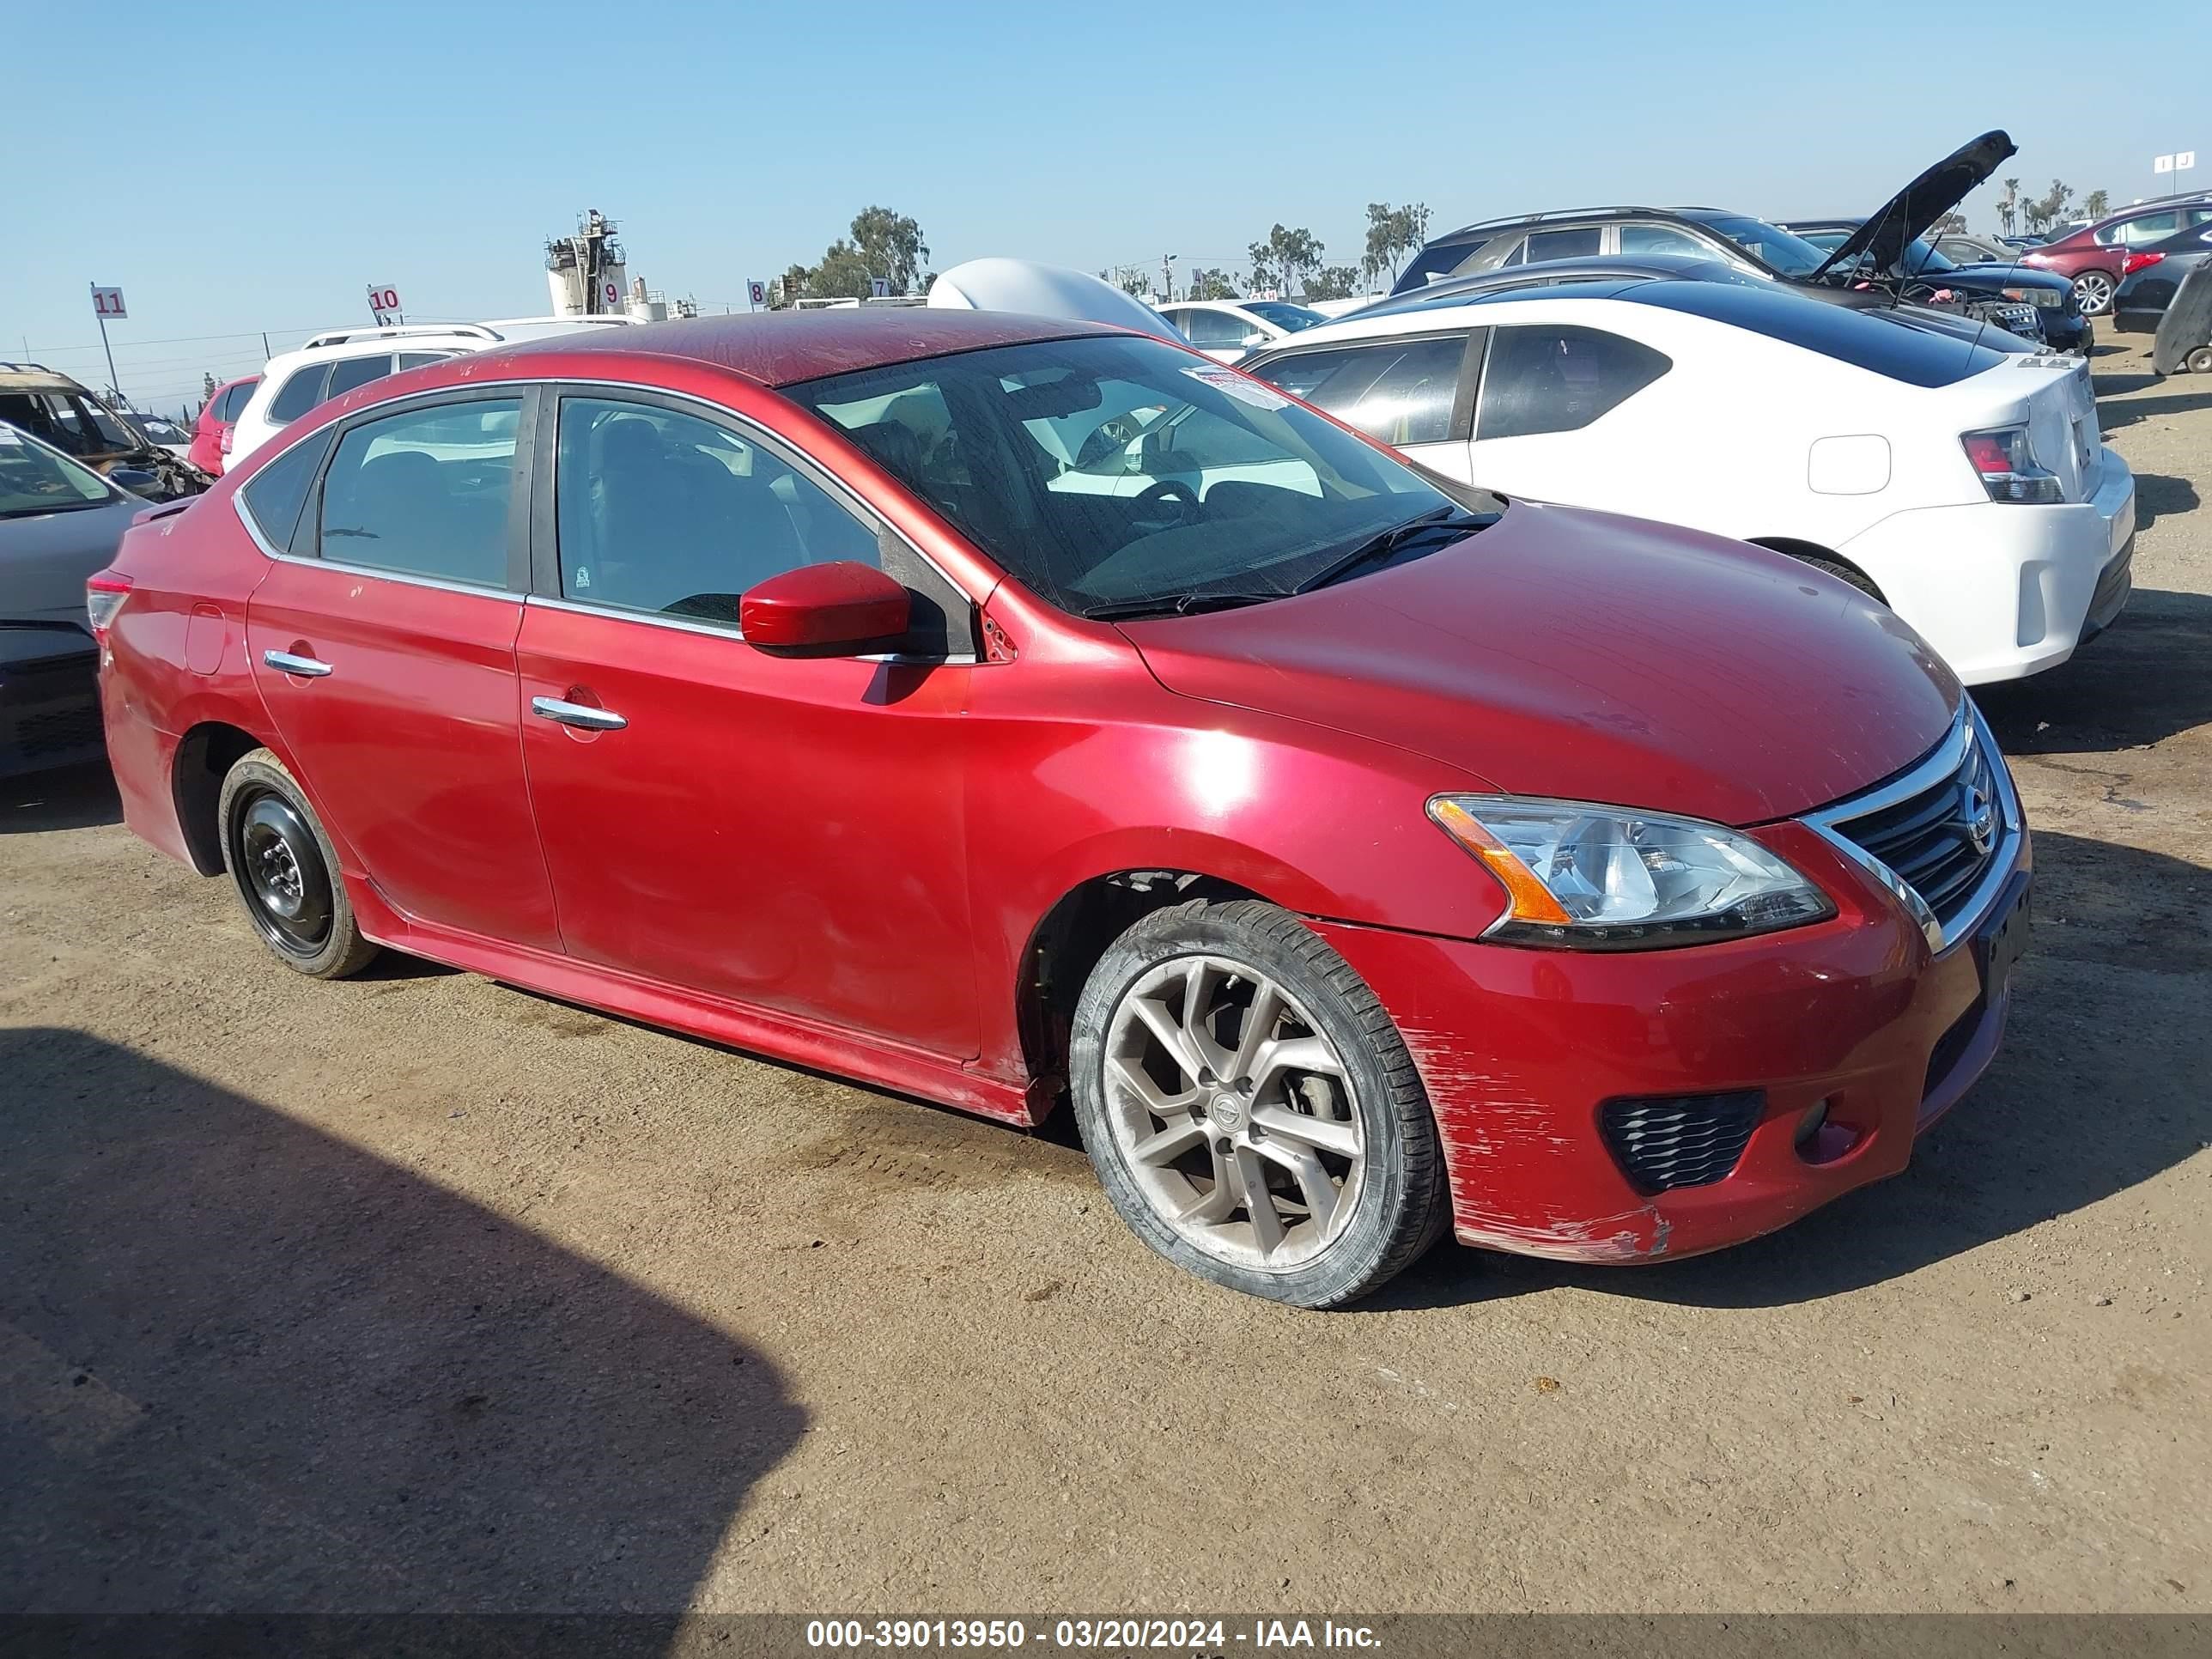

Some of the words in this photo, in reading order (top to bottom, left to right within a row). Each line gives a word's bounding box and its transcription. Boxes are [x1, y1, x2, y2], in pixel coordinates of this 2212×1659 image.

[2180, 154, 2189, 166] J
[1194, 270, 1202, 284] 4
[605, 283, 617, 303] 9
[751, 284, 763, 302] 8
[875, 281, 885, 296] 7
[93, 293, 125, 314] 11
[370, 289, 398, 311] 10
